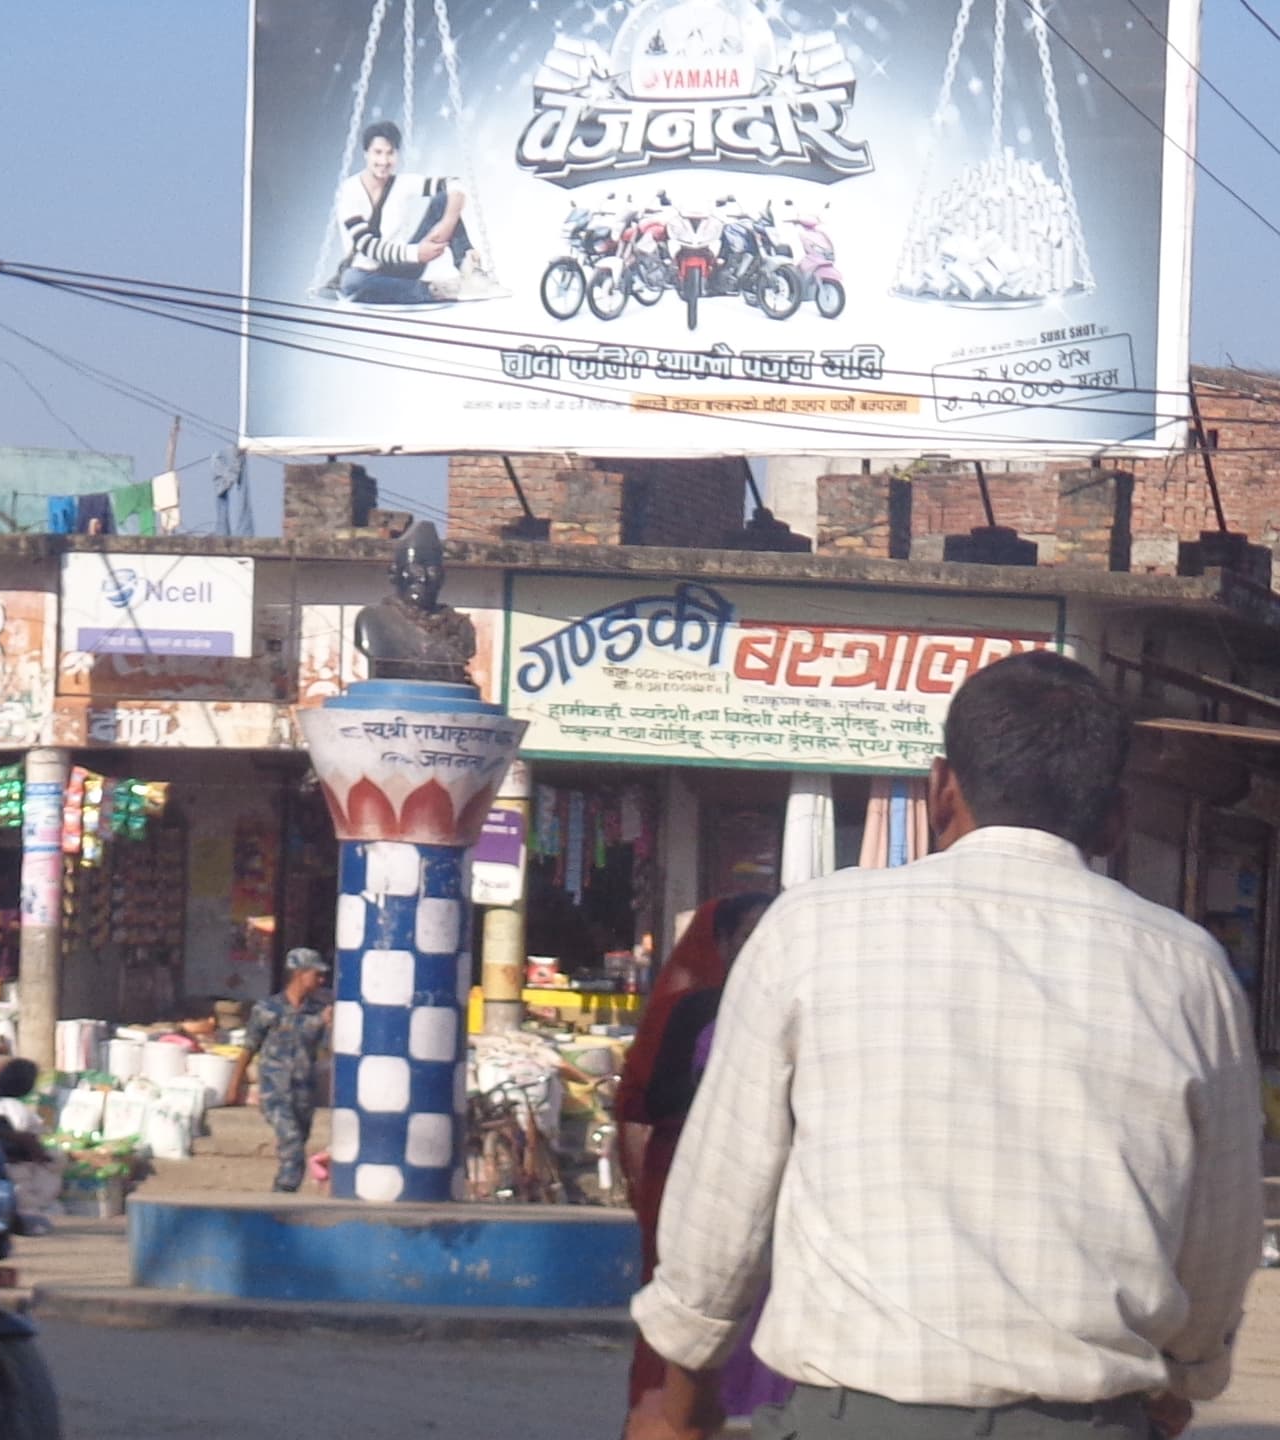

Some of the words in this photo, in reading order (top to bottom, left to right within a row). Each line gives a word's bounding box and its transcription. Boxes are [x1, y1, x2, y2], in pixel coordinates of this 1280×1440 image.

[663, 68, 740, 89] YAMAHA
[517, 86, 874, 174] वजनदार
[145, 579, 213, 603] Ncell
[516, 582, 735, 693] गण्डकी
[732, 619, 1050, 694] बस्त्राल
